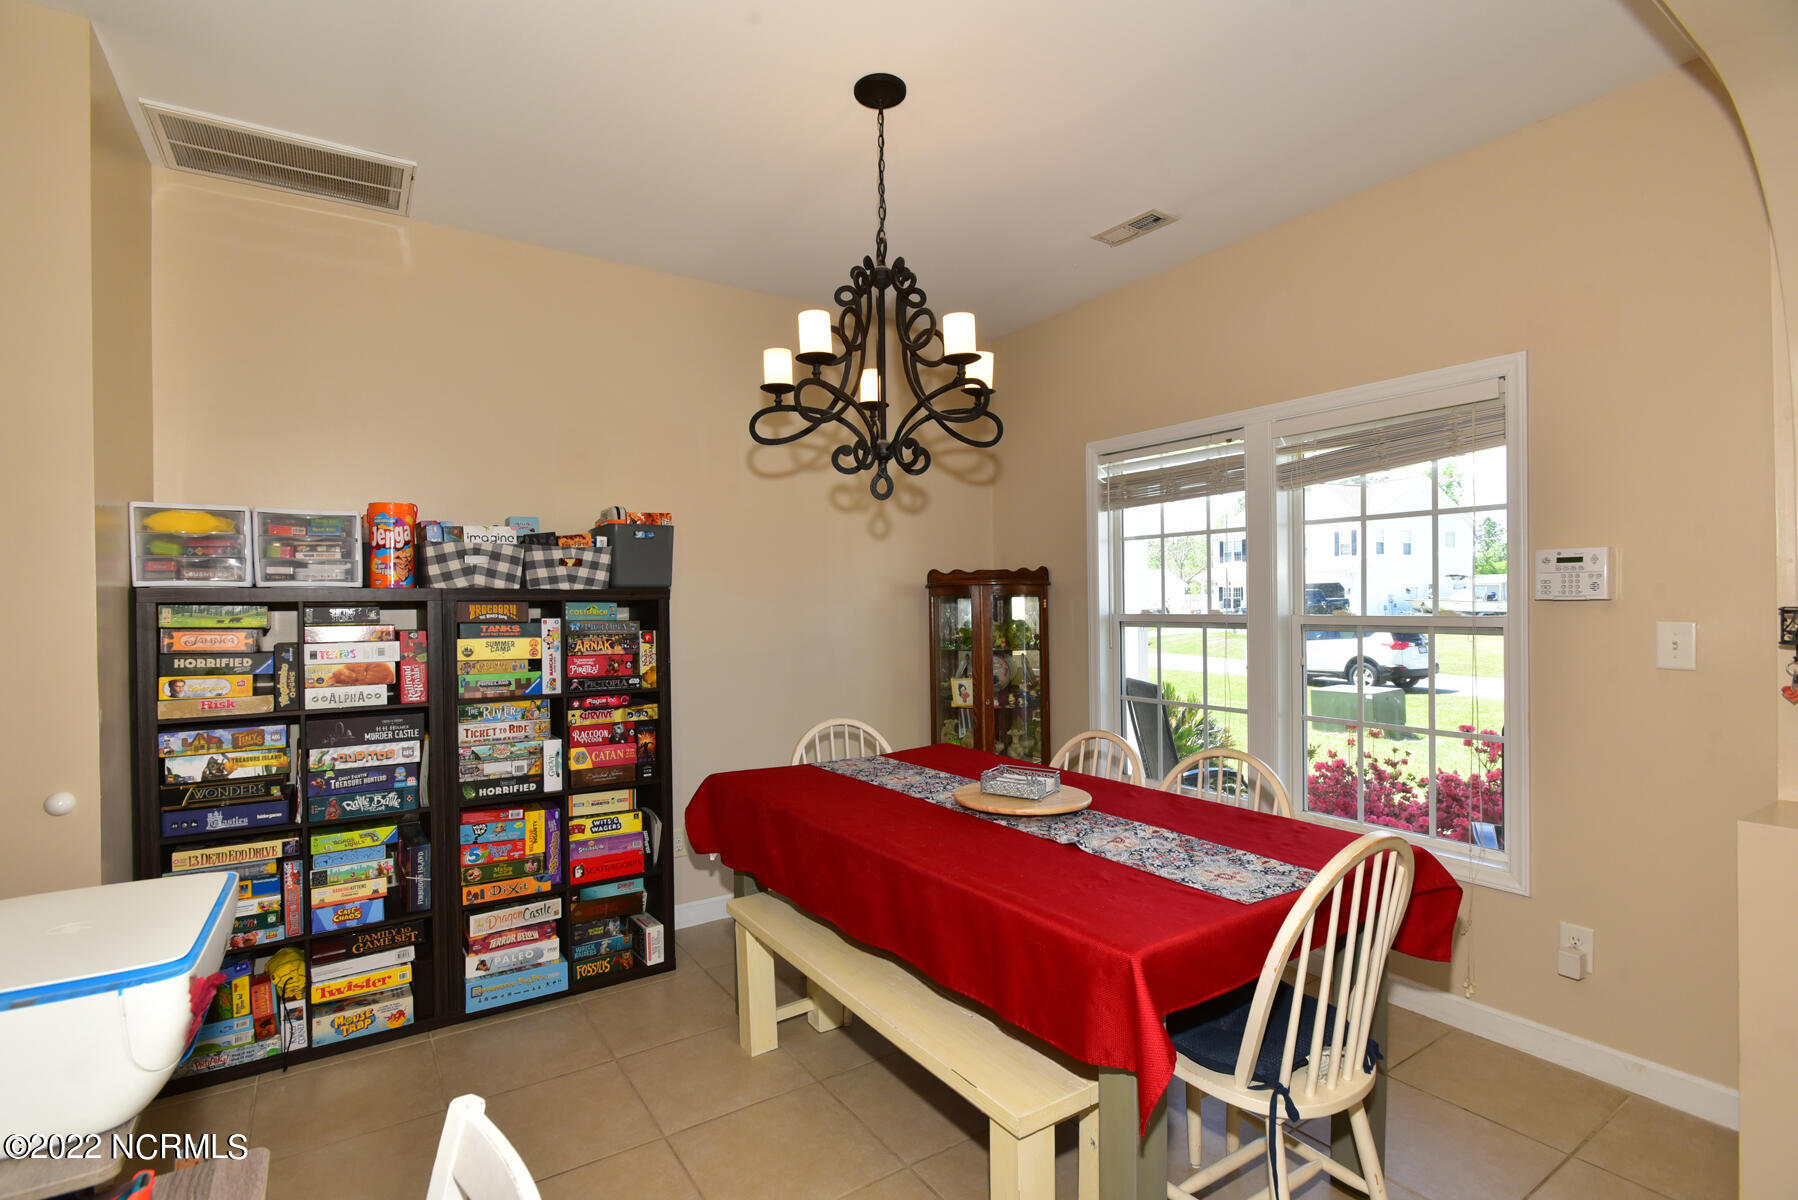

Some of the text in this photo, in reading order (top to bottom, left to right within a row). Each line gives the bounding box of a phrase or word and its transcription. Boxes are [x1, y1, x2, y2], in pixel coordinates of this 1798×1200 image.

[372, 526, 411, 548] Jenga
[466, 532, 515, 544] imagine
[485, 640, 515, 648] SUMMER
[574, 640, 612, 652] ARNAK
[320, 648, 356, 660] TETRIS
[174, 658, 252, 668] HORRIFIED
[403, 665, 420, 701] Railroad
[329, 692, 366, 704] ALPHA
[201, 700, 236, 710] Risk
[466, 705, 516, 720] THE RIVER
[580, 710, 614, 720] SURVIVE
[364, 728, 420, 741] MURDER CASTLE
[464, 728, 497, 738] TICKET
[508, 724, 529, 734] RIDE
[572, 730, 609, 742] RACCOON
[592, 749, 624, 762] CATAN
[330, 778, 362, 789] TREASURE
[479, 783, 536, 796] HORRIFIED
[192, 784, 265, 799] WONDERS
[592, 824, 621, 833] WAGERS
[188, 846, 278, 868] 13 DEAD END DRIVE
[332, 912, 361, 922] CHAOS
[352, 930, 418, 954] GAME SET
[358, 928, 397, 943] FAMILY
[489, 930, 539, 950] TERROR BELOW
[576, 944, 596, 953] WRECK
[494, 950, 534, 966] PALEO
[576, 958, 610, 980] FOSSILIS
[316, 975, 392, 998] Twister
[334, 1008, 374, 1029] MOUSE
[340, 1018, 372, 1037] TRAP
